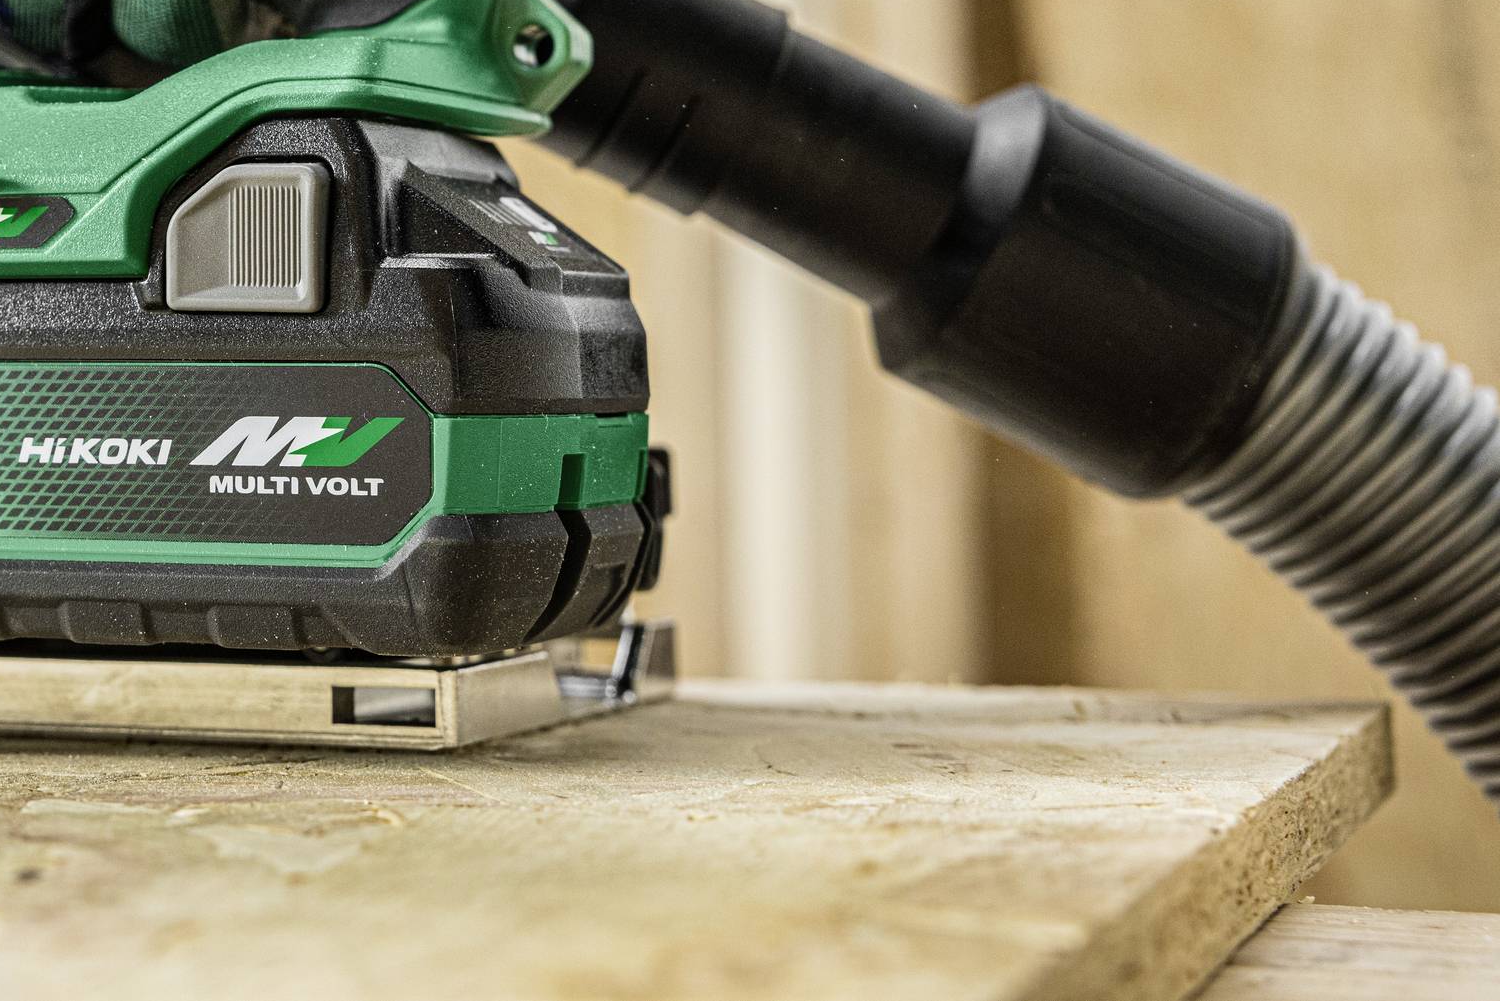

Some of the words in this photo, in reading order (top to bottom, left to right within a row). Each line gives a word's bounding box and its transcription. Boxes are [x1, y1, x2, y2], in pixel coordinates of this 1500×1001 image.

[17, 436, 173, 466] HiKOKI
[208, 474, 299, 496] MULTI
[304, 476, 385, 497] VOLT
